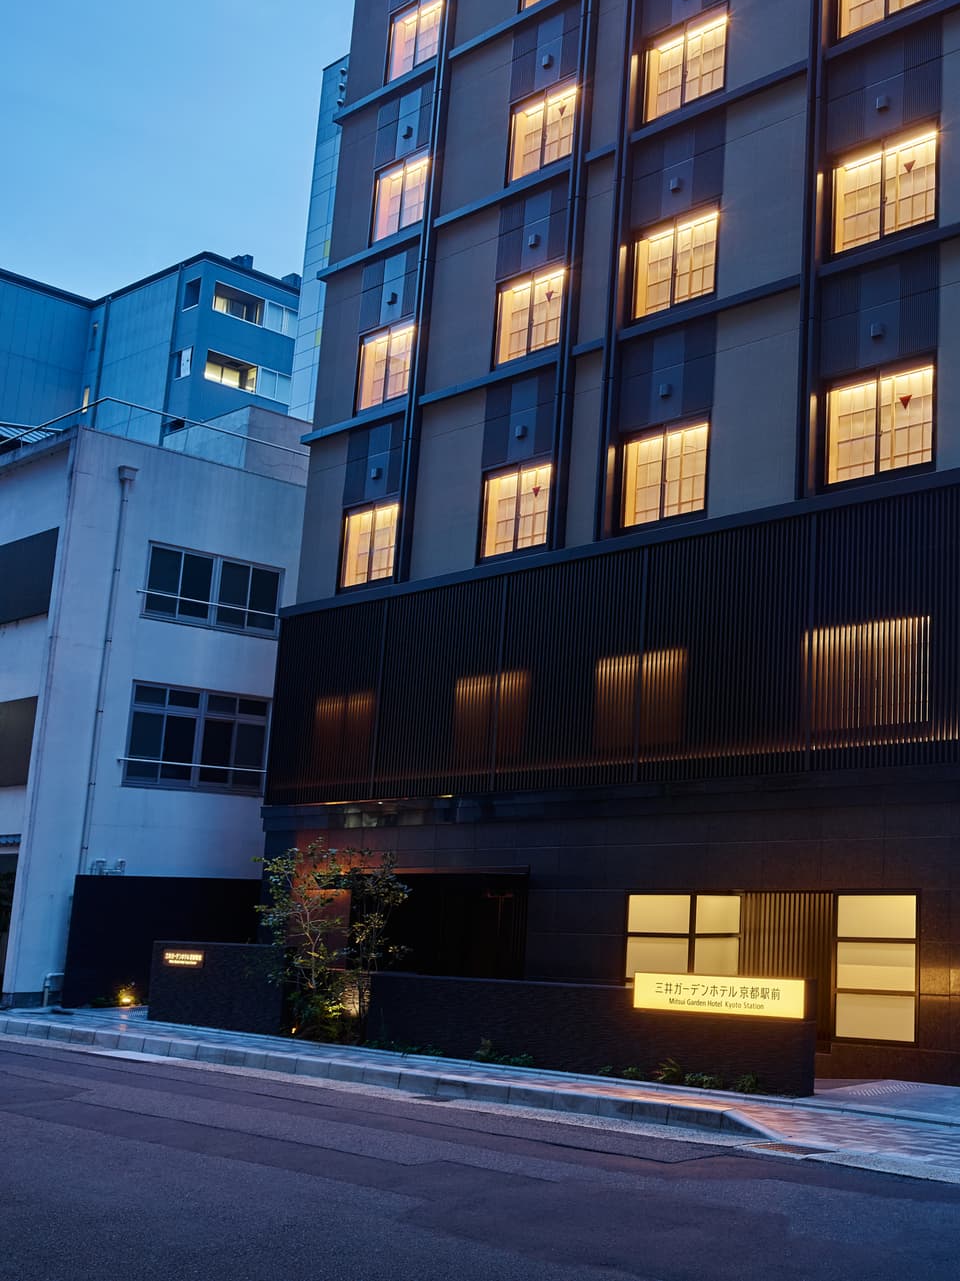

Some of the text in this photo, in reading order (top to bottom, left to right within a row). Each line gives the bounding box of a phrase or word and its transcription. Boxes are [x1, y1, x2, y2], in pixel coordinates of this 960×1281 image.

[655, 982, 781, 1001] 三井ガーデンホテル京都駅前
[668, 997, 765, 1010] Mitsui Garden Hotel Kyoto Station
